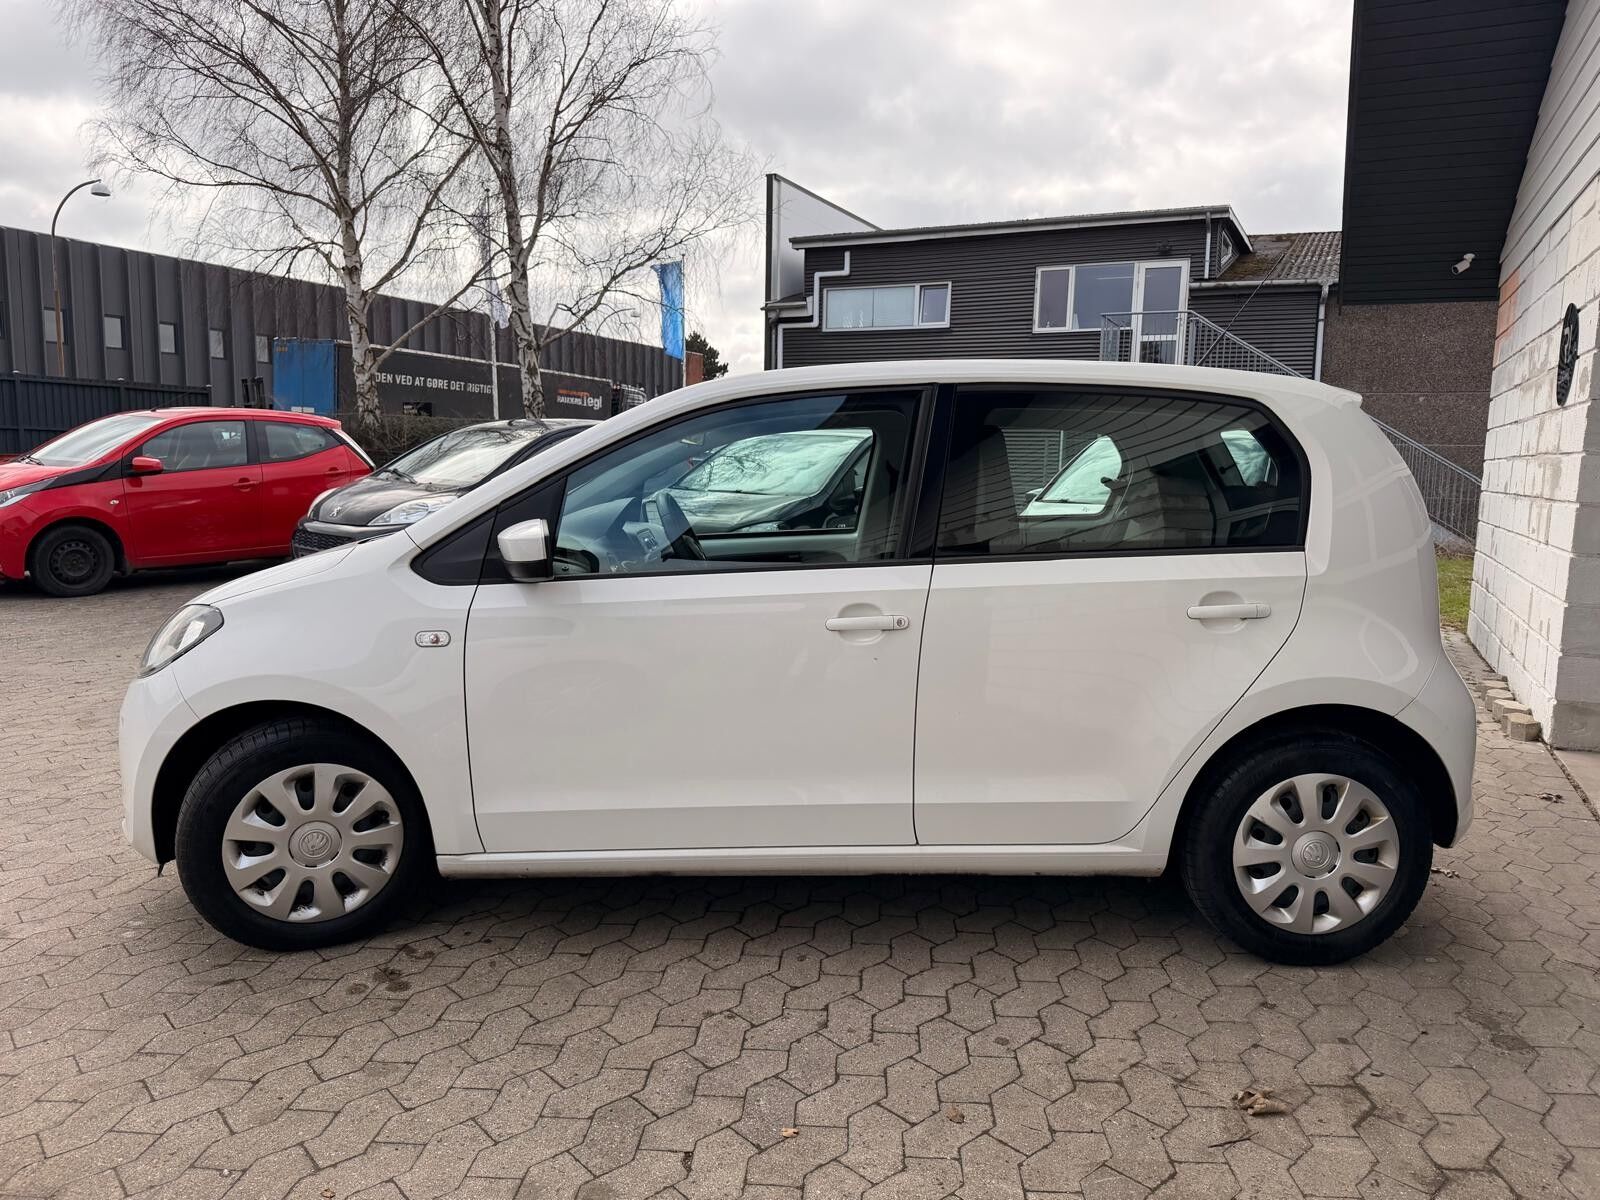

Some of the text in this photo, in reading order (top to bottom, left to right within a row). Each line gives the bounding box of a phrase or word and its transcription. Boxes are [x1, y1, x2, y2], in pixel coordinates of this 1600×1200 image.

[395, 374, 412, 386] VED
[414, 376, 424, 387] AT
[426, 378, 449, 390] GØRE
[450, 381, 465, 391] DET
